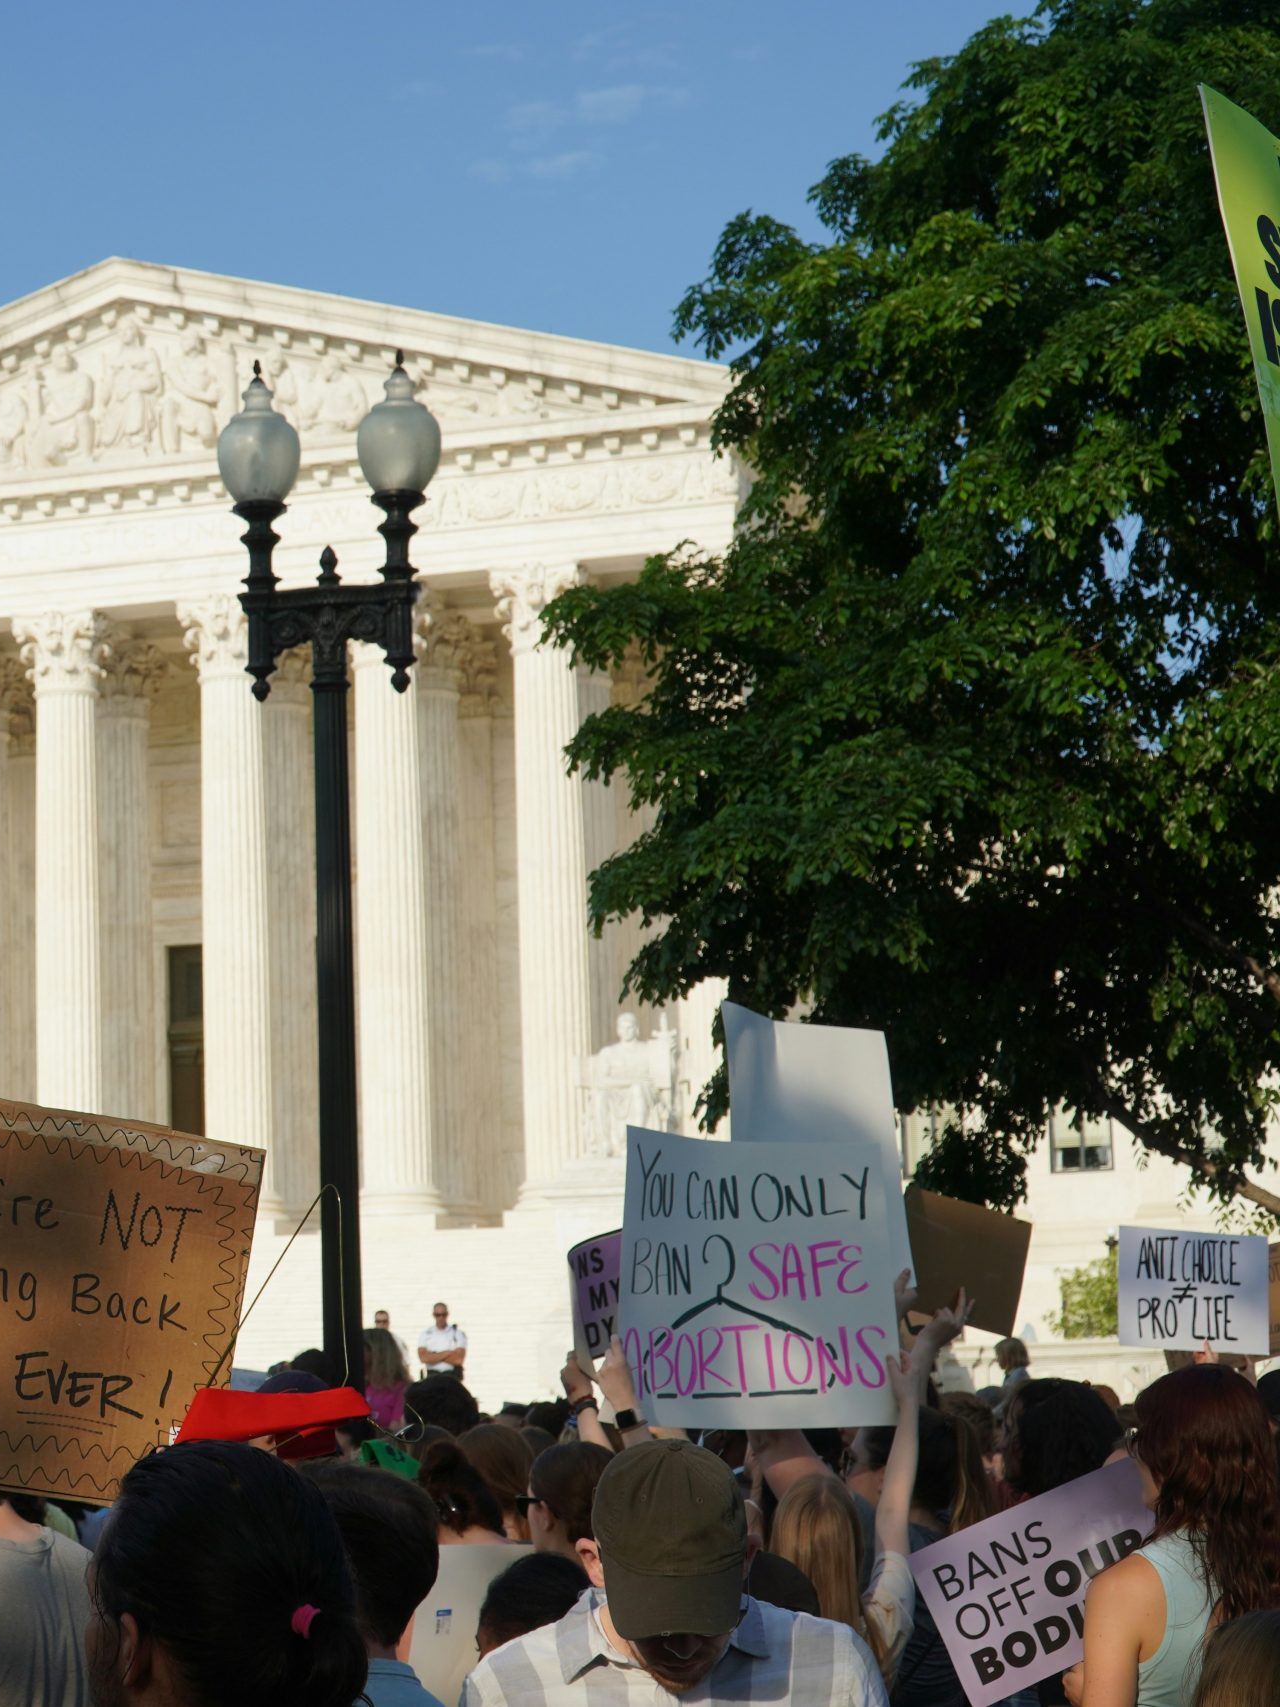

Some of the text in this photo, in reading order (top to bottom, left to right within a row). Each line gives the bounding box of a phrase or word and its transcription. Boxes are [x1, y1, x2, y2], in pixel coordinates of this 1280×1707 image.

[636, 1143, 869, 1223] YOU CAN ONLY
[99, 1189, 203, 1263] NOT
[569, 1248, 604, 1280] NS
[631, 1236, 870, 1301] BAN SAFE
[1136, 1236, 1179, 1283] ANTI
[1182, 1239, 1242, 1286] CHOICE
[71, 1273, 188, 1332] Back
[1137, 1295, 1239, 1341] PRO LIFE
[624, 1325, 887, 1400] ABORTIONS
[931, 1520, 1053, 1603] BANS
[954, 1575, 1036, 1641] OFF
[970, 1600, 1086, 1686] BODI
